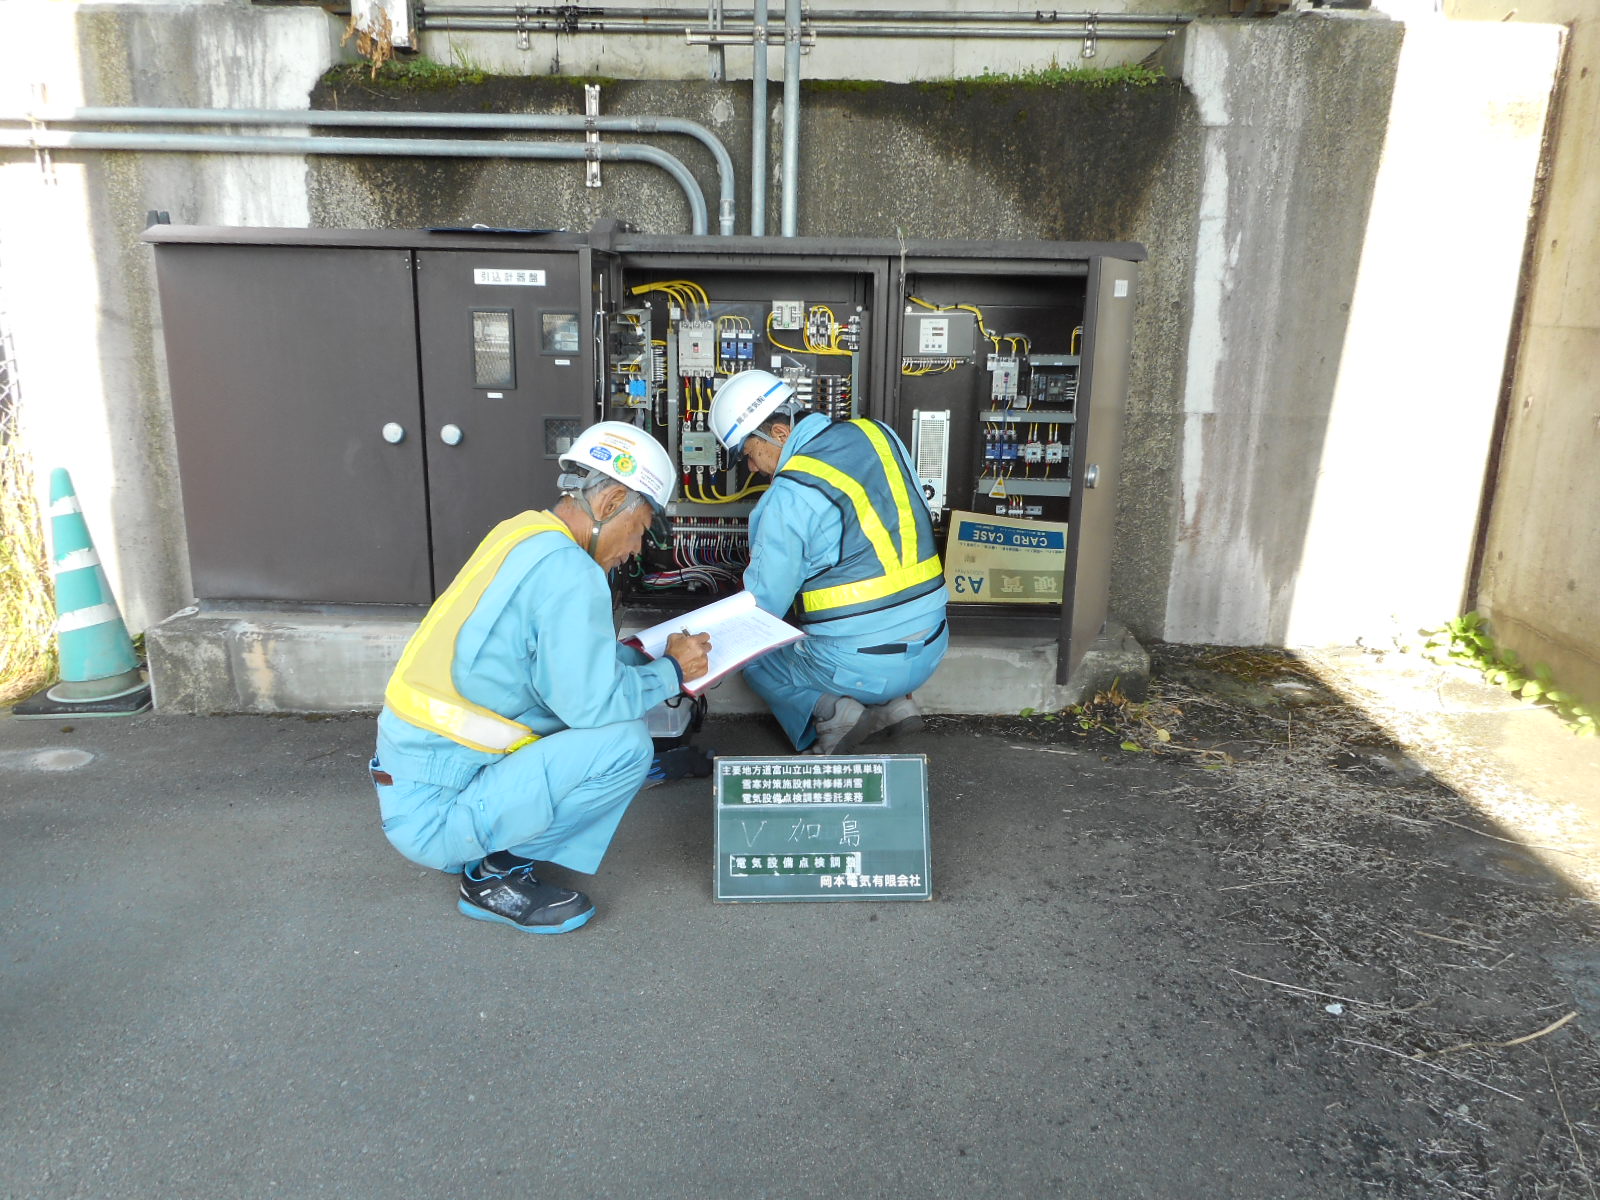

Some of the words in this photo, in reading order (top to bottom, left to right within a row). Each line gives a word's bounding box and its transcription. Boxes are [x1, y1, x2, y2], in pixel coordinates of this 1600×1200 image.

[972, 529, 1004, 543] CASE
[1012, 534, 1048, 547] CARD
[954, 575, 985, 594] A3
[1000, 575, 1058, 593] 硬質
[820, 874, 921, 888] 岡本電気有限会社
